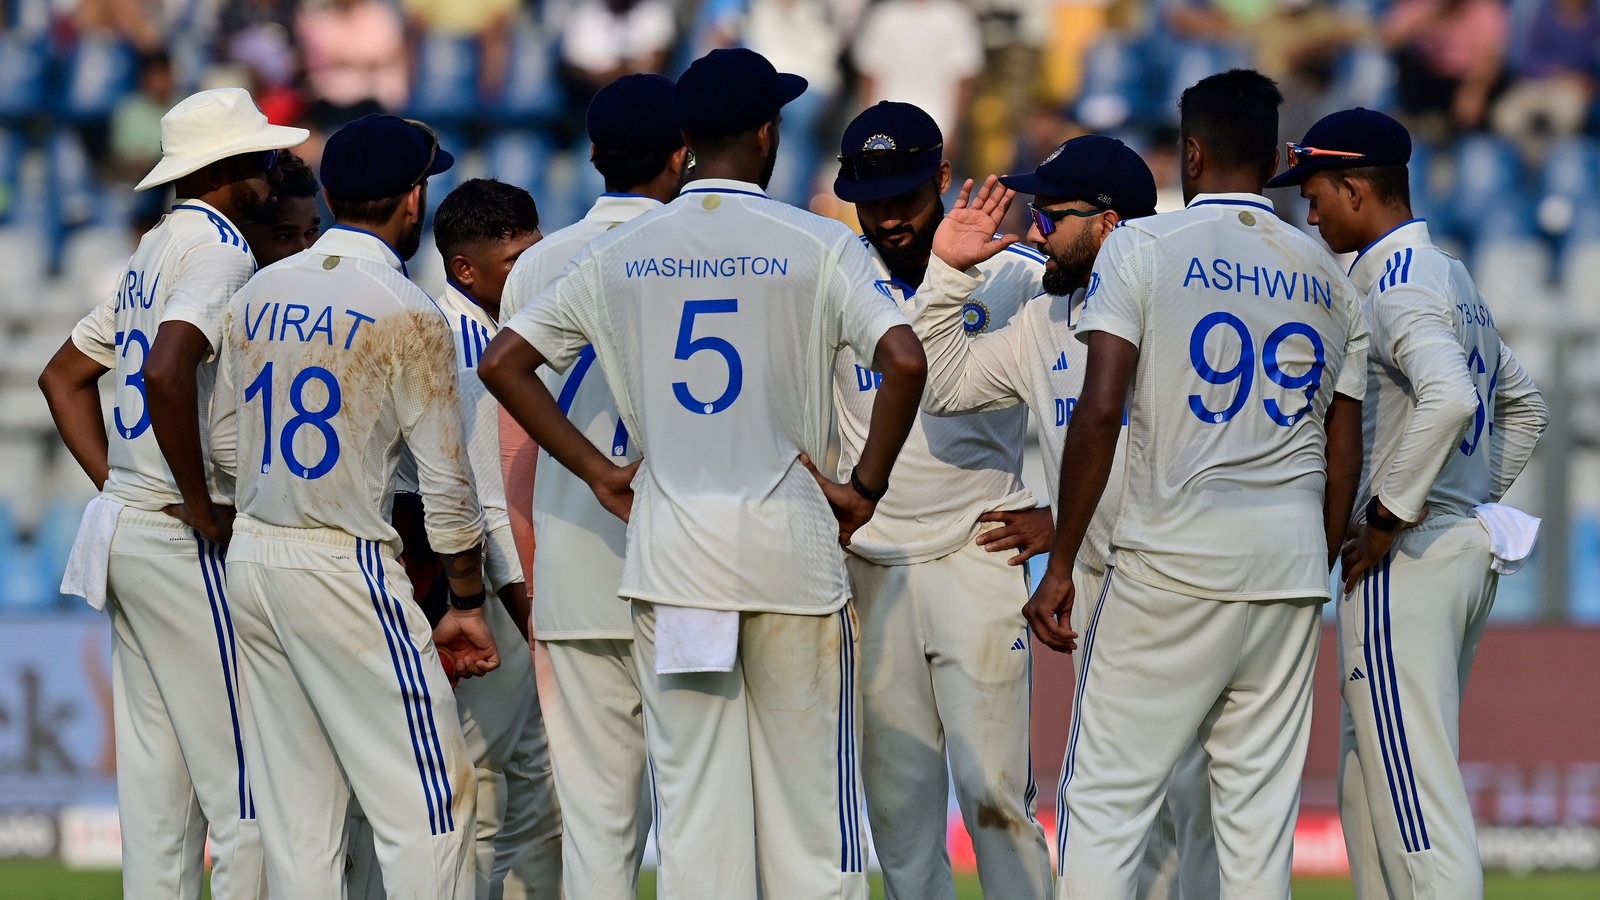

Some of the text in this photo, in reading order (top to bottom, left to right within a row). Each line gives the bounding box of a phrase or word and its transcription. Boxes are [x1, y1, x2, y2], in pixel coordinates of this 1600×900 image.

[1097, 193, 1112, 204] 280
[625, 256, 789, 278] WASHINGTON
[1183, 257, 1332, 309] ASHWIN
[245, 302, 376, 350] VIRAT
[672, 298, 743, 415] 5
[114, 329, 152, 440] 3
[1188, 311, 1327, 427] 99
[245, 361, 341, 480] 18
